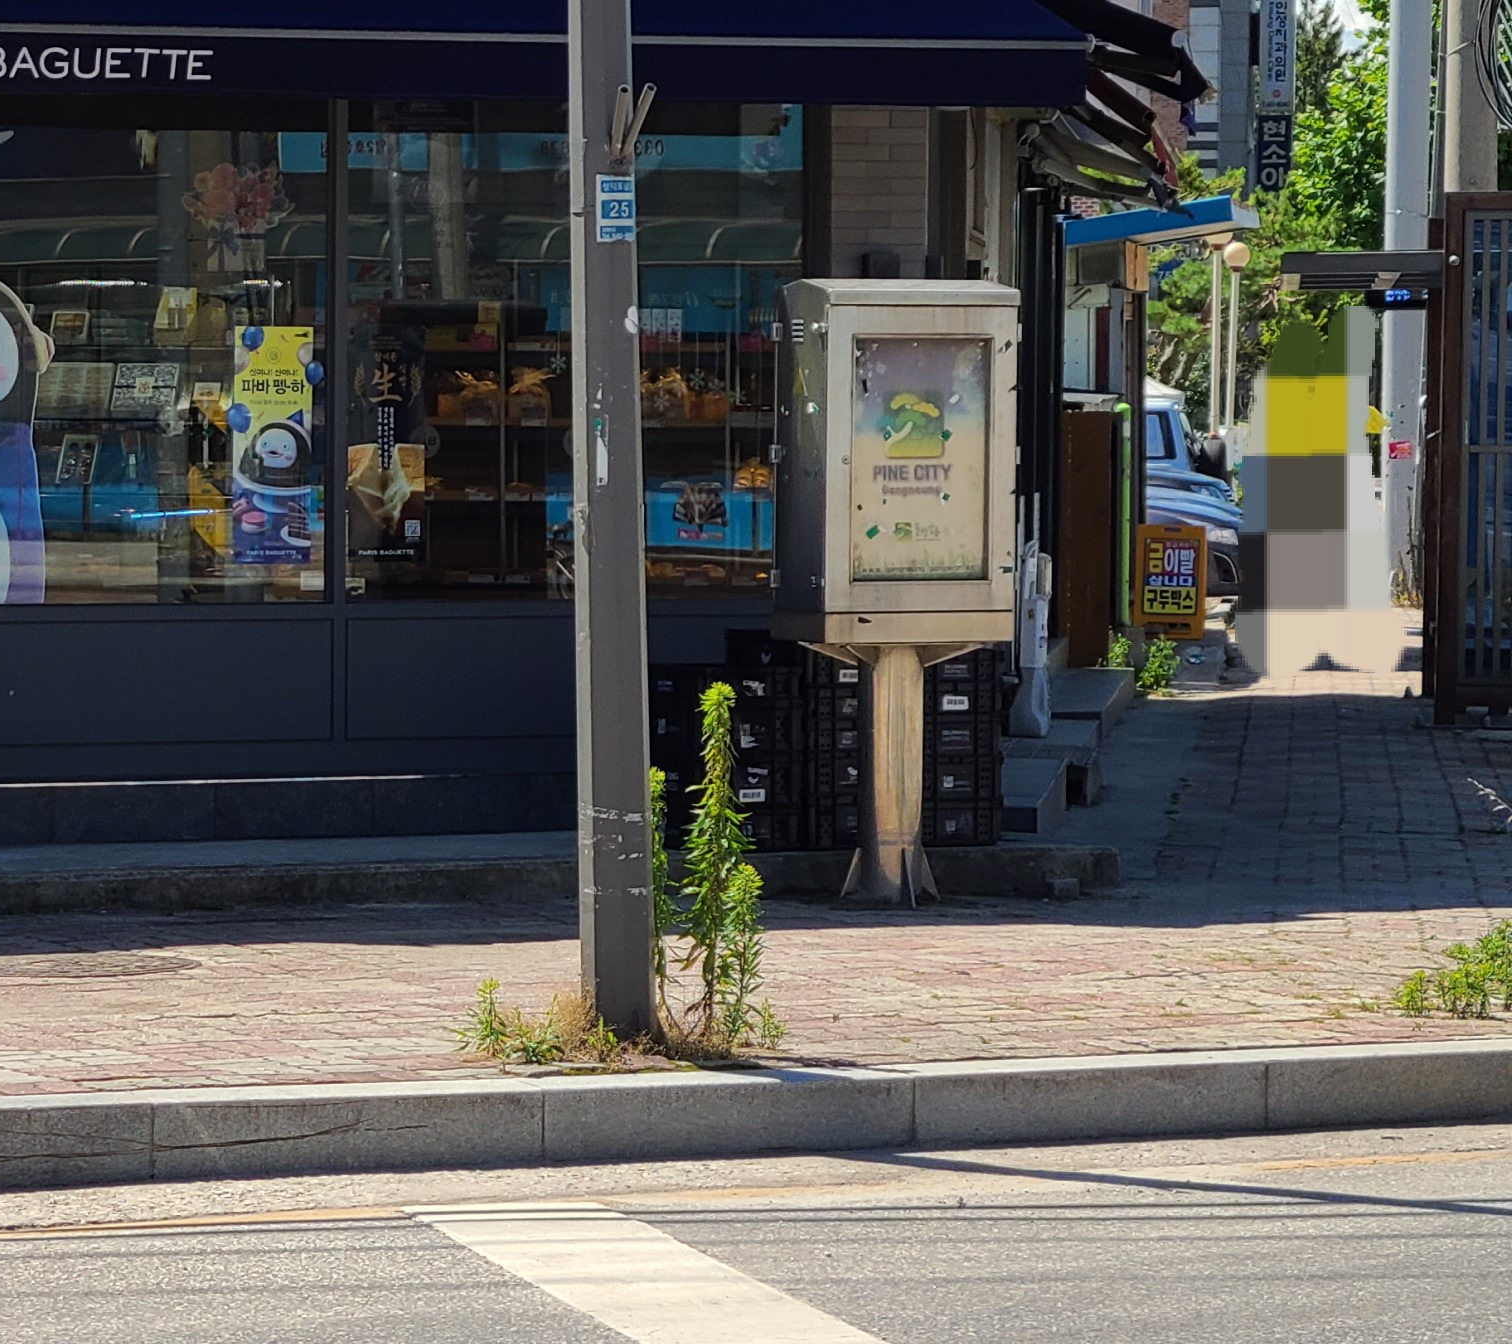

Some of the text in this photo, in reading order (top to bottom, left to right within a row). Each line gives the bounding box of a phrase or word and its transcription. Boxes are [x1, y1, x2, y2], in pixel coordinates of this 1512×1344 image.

[1261, 119, 1287, 189] 현소아
[609, 201, 629, 217] 25
[241, 378, 270, 395] 파바
[368, 362, 403, 404] 生
[872, 463, 952, 481] PINE CITY
[882, 485, 942, 498] Gangneung
[1148, 575, 1193, 586] 삽니다
[1146, 589, 1194, 610] 구두박스
